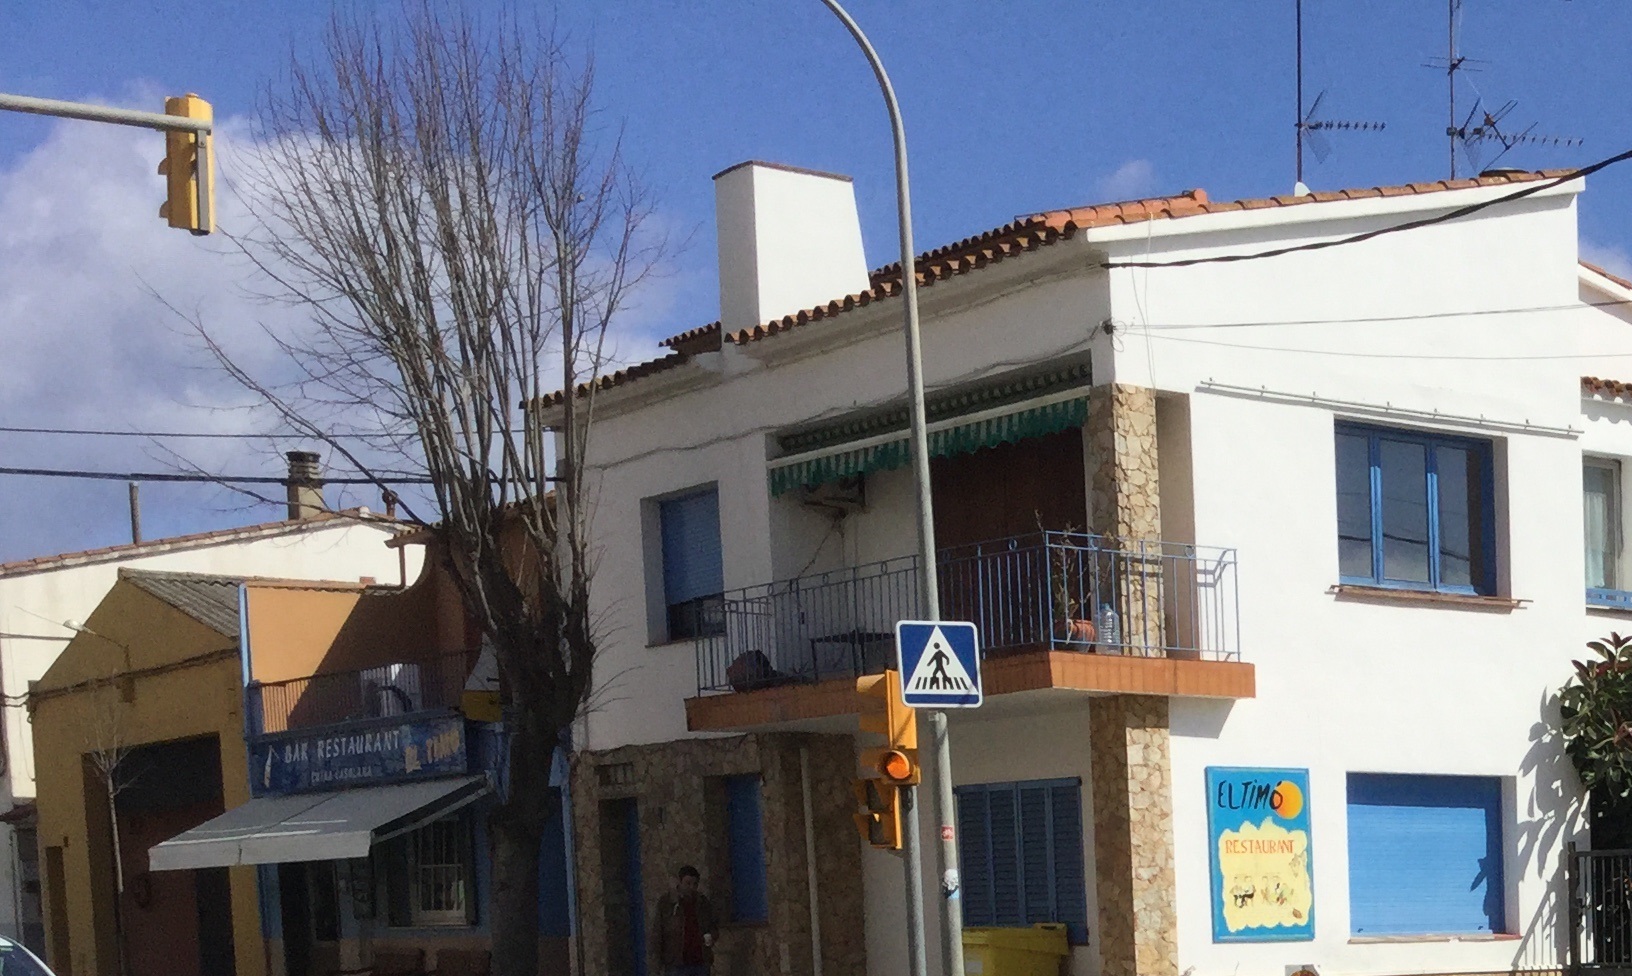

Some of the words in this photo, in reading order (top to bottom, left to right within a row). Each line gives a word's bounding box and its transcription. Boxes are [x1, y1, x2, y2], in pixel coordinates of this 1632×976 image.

[284, 742, 309, 764] BAR
[317, 730, 401, 760] RESTAURANT
[1225, 839, 1295, 854] RESTAURANT
